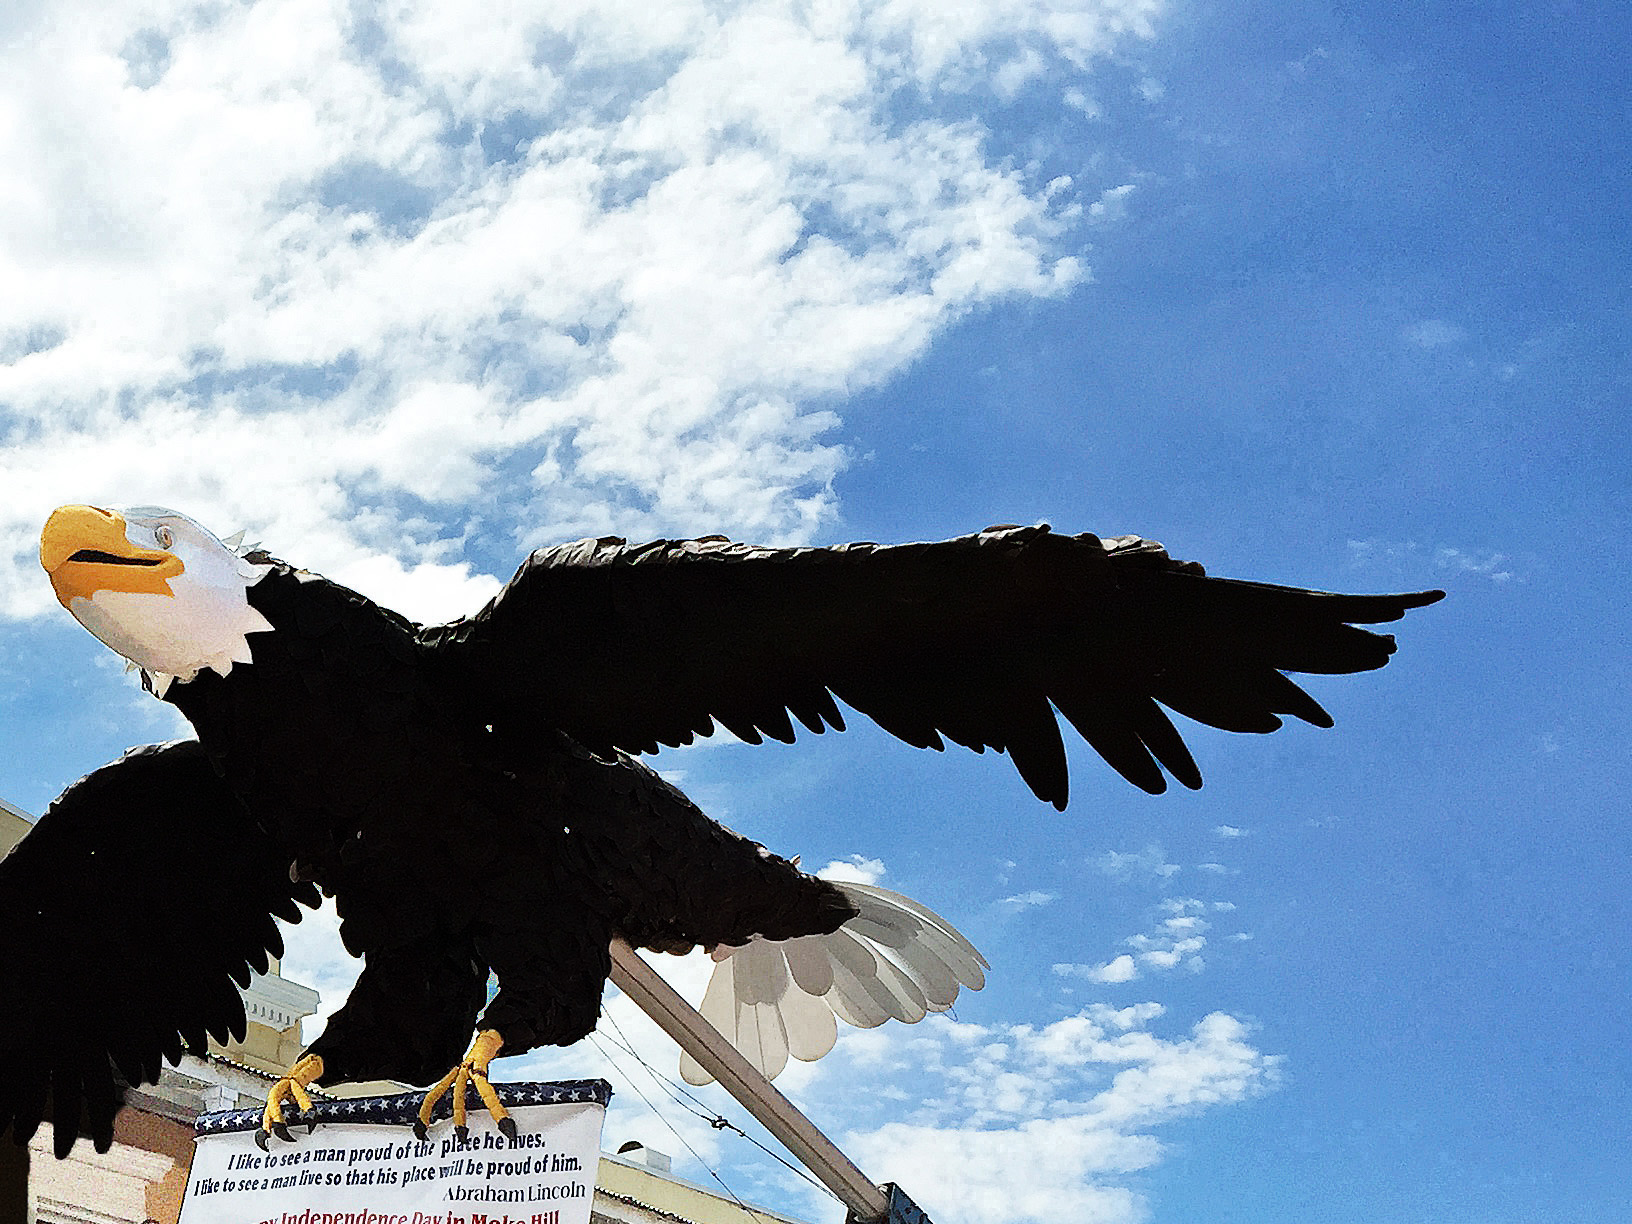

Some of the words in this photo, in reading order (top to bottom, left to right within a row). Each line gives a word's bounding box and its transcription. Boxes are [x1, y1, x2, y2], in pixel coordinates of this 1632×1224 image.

[228, 1155, 235, 1170] I
[236, 1154, 261, 1170] like
[264, 1154, 277, 1168] to
[280, 1154, 301, 1166] see
[303, 1151, 310, 1163] a
[313, 1149, 345, 1162] man
[348, 1142, 393, 1166] proud
[396, 1141, 411, 1159] of
[414, 1140, 435, 1158] the
[440, 1133, 480, 1158] place
[483, 1131, 504, 1150] he
[194, 1180, 200, 1196] I
[201, 1178, 220, 1195] like
[222, 1178, 235, 1192] to
[237, 1179, 258, 1192] see
[261, 1179, 268, 1190] a
[271, 1174, 297, 1189] man
[299, 1170, 323, 1186] live
[325, 1174, 342, 1185] so
[346, 1169, 376, 1186] that
[376, 1168, 397, 1185] his
[401, 1166, 435, 1188] place
[439, 1159, 465, 1179] will
[466, 1159, 483, 1176] be
[486, 1156, 531, 1180] proud
[534, 1154, 549, 1174] of
[551, 1153, 582, 1172] him.
[442, 1184, 524, 1202] Abraham
[528, 1181, 586, 1202] Lincoln
